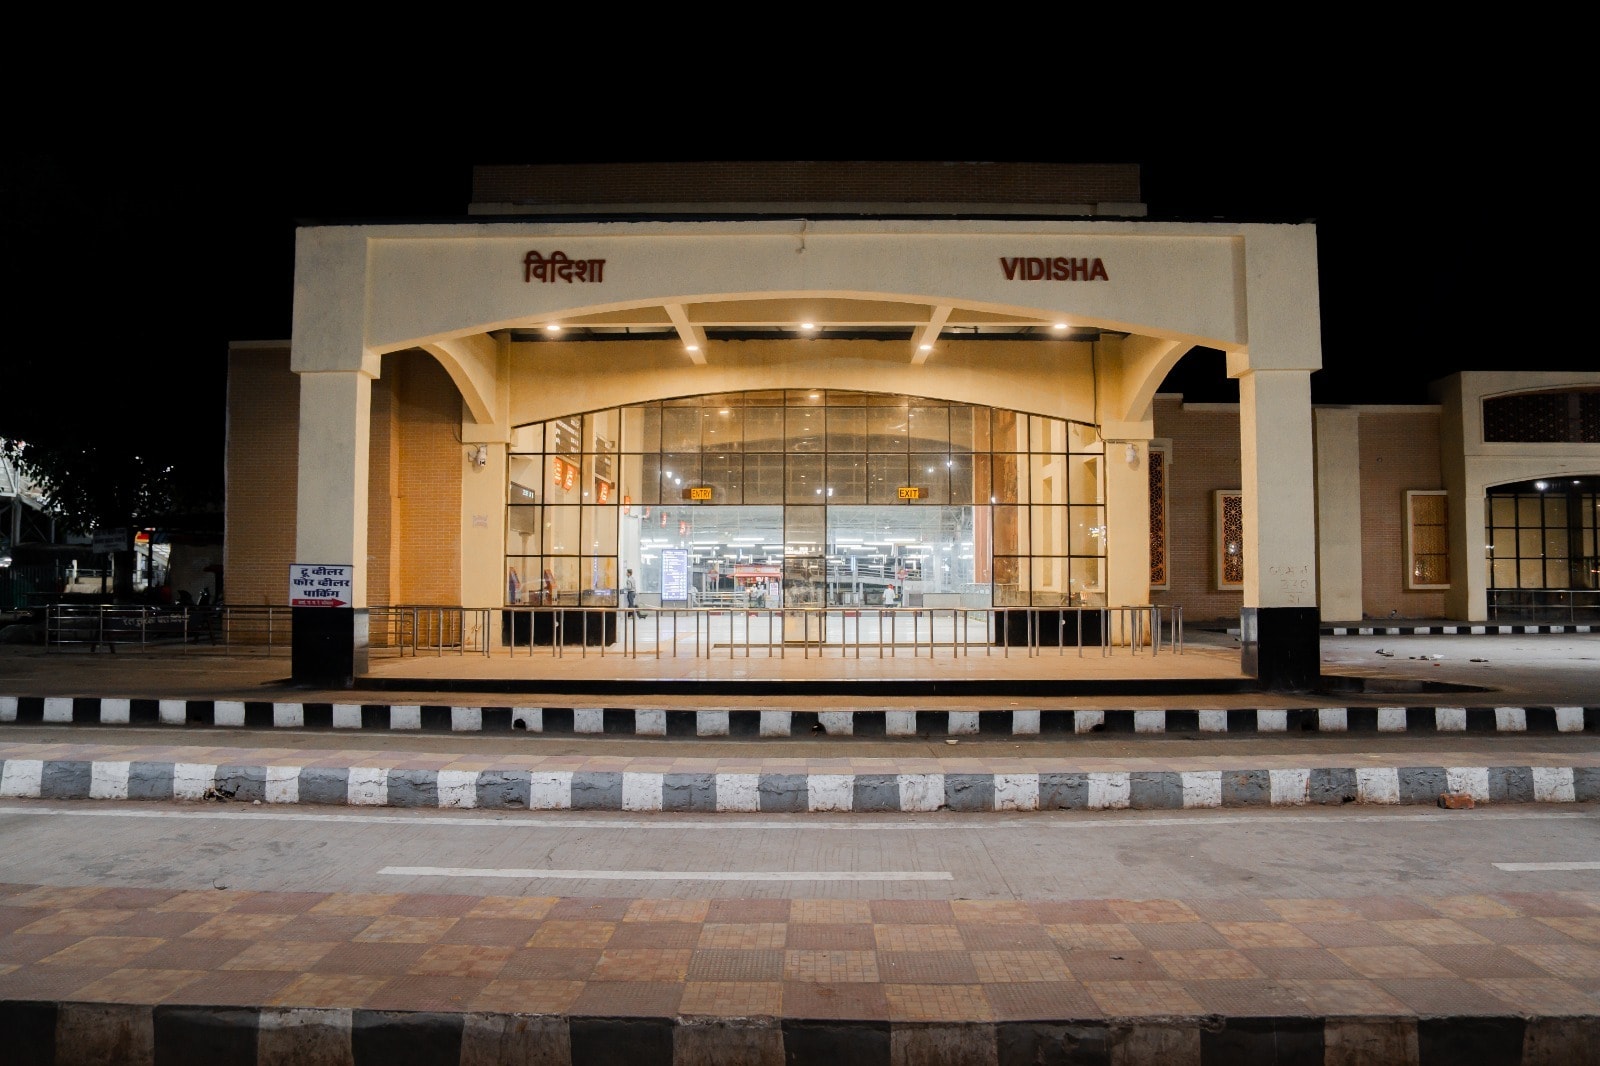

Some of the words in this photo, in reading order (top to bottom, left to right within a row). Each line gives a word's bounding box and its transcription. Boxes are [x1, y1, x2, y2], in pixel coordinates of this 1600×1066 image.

[523, 250, 606, 283] विदिशा
[1000, 257, 1109, 281] VIDISHA
[692, 490, 711, 498] ENTRY
[899, 489, 917, 498] EXIT
